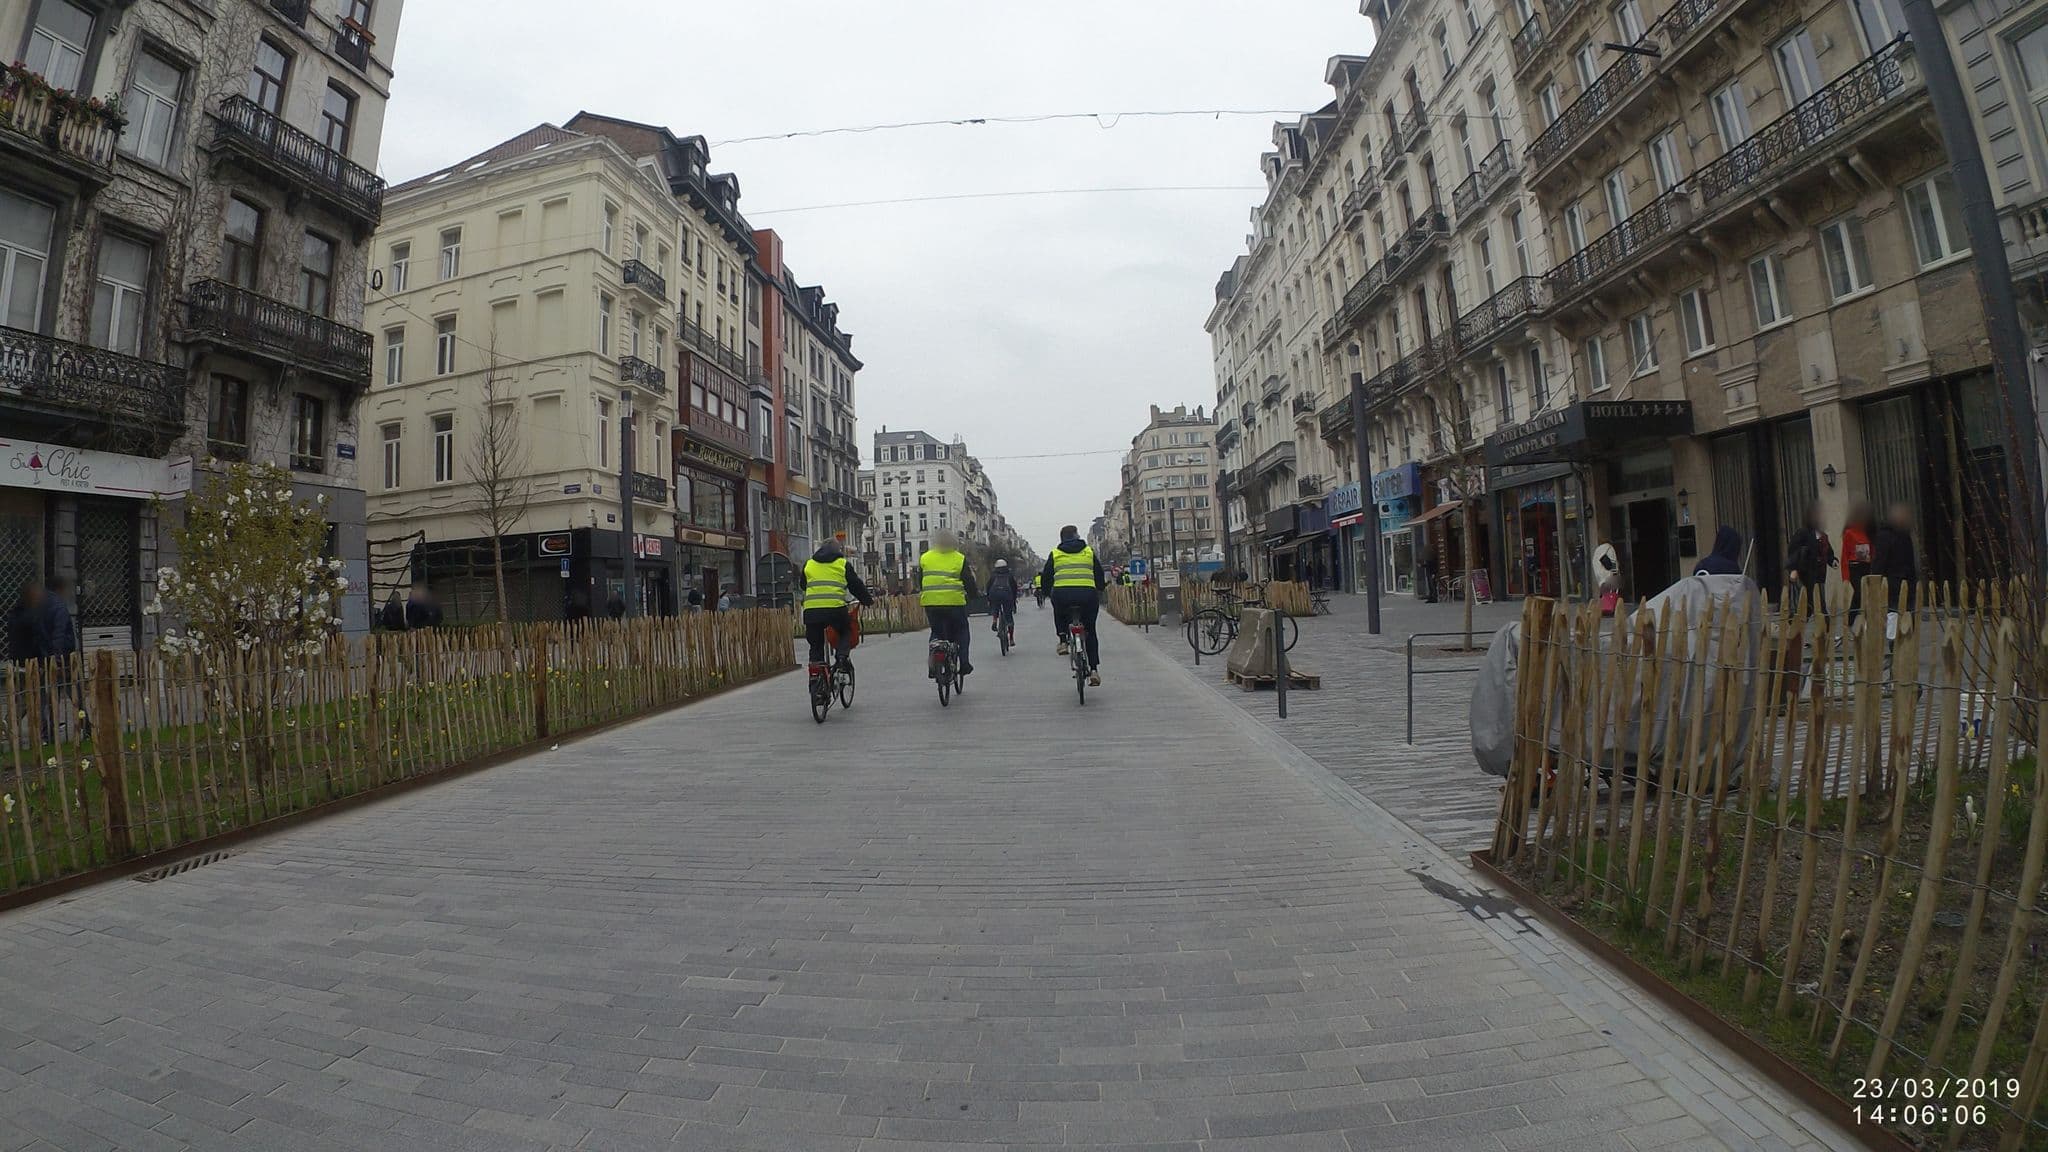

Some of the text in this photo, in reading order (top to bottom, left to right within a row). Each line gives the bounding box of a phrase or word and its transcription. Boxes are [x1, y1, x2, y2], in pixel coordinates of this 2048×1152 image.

[1591, 405, 1637, 417] HOTEL
[47, 449, 91, 480] Chic
[1334, 472, 1402, 512] REPAIR ENTER
